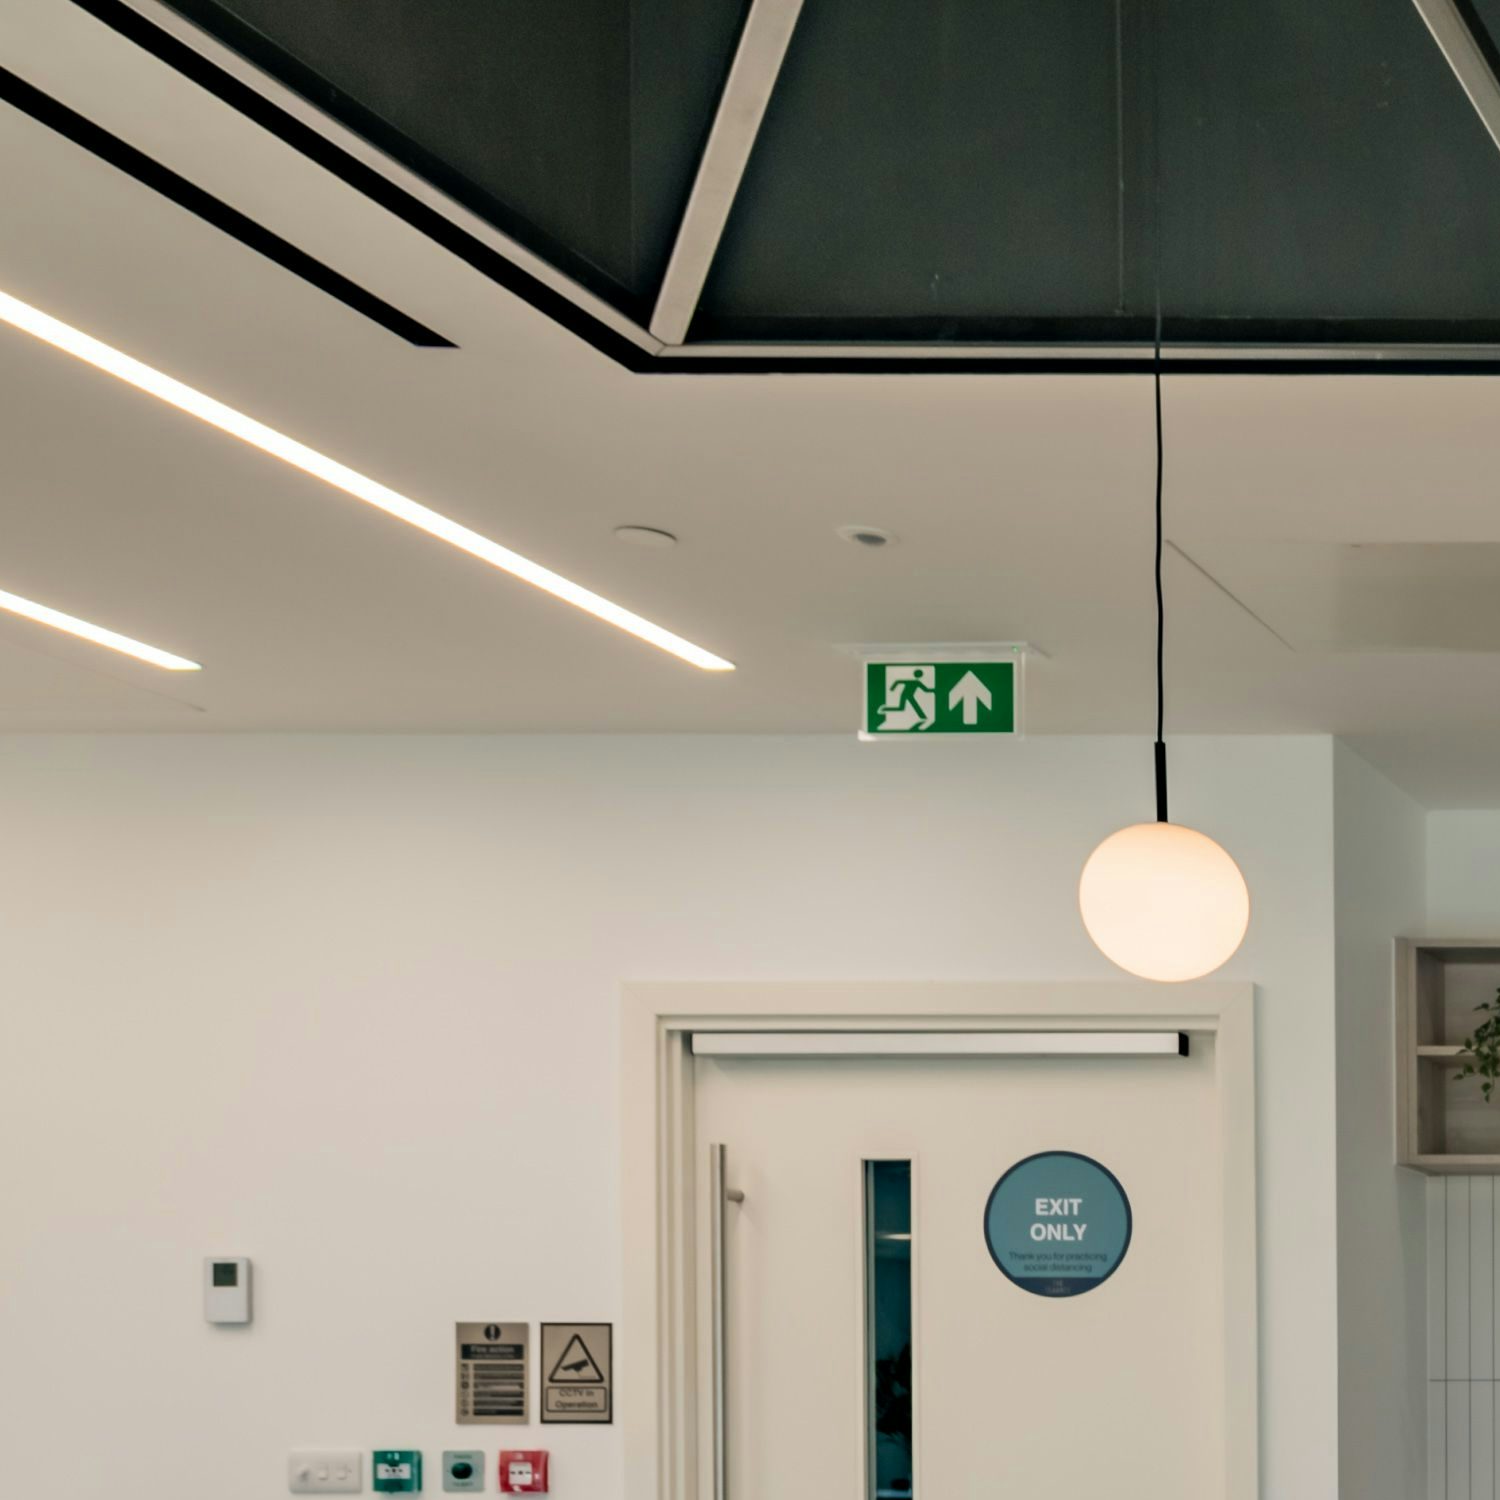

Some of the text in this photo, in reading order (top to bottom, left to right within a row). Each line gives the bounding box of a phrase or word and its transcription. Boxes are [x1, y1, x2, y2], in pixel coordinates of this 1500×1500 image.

[1034, 1198, 1083, 1216] EXIT
[1029, 1222, 1088, 1241] ONLY
[558, 1388, 584, 1398] CCTV
[554, 1401, 599, 1411] Operation
